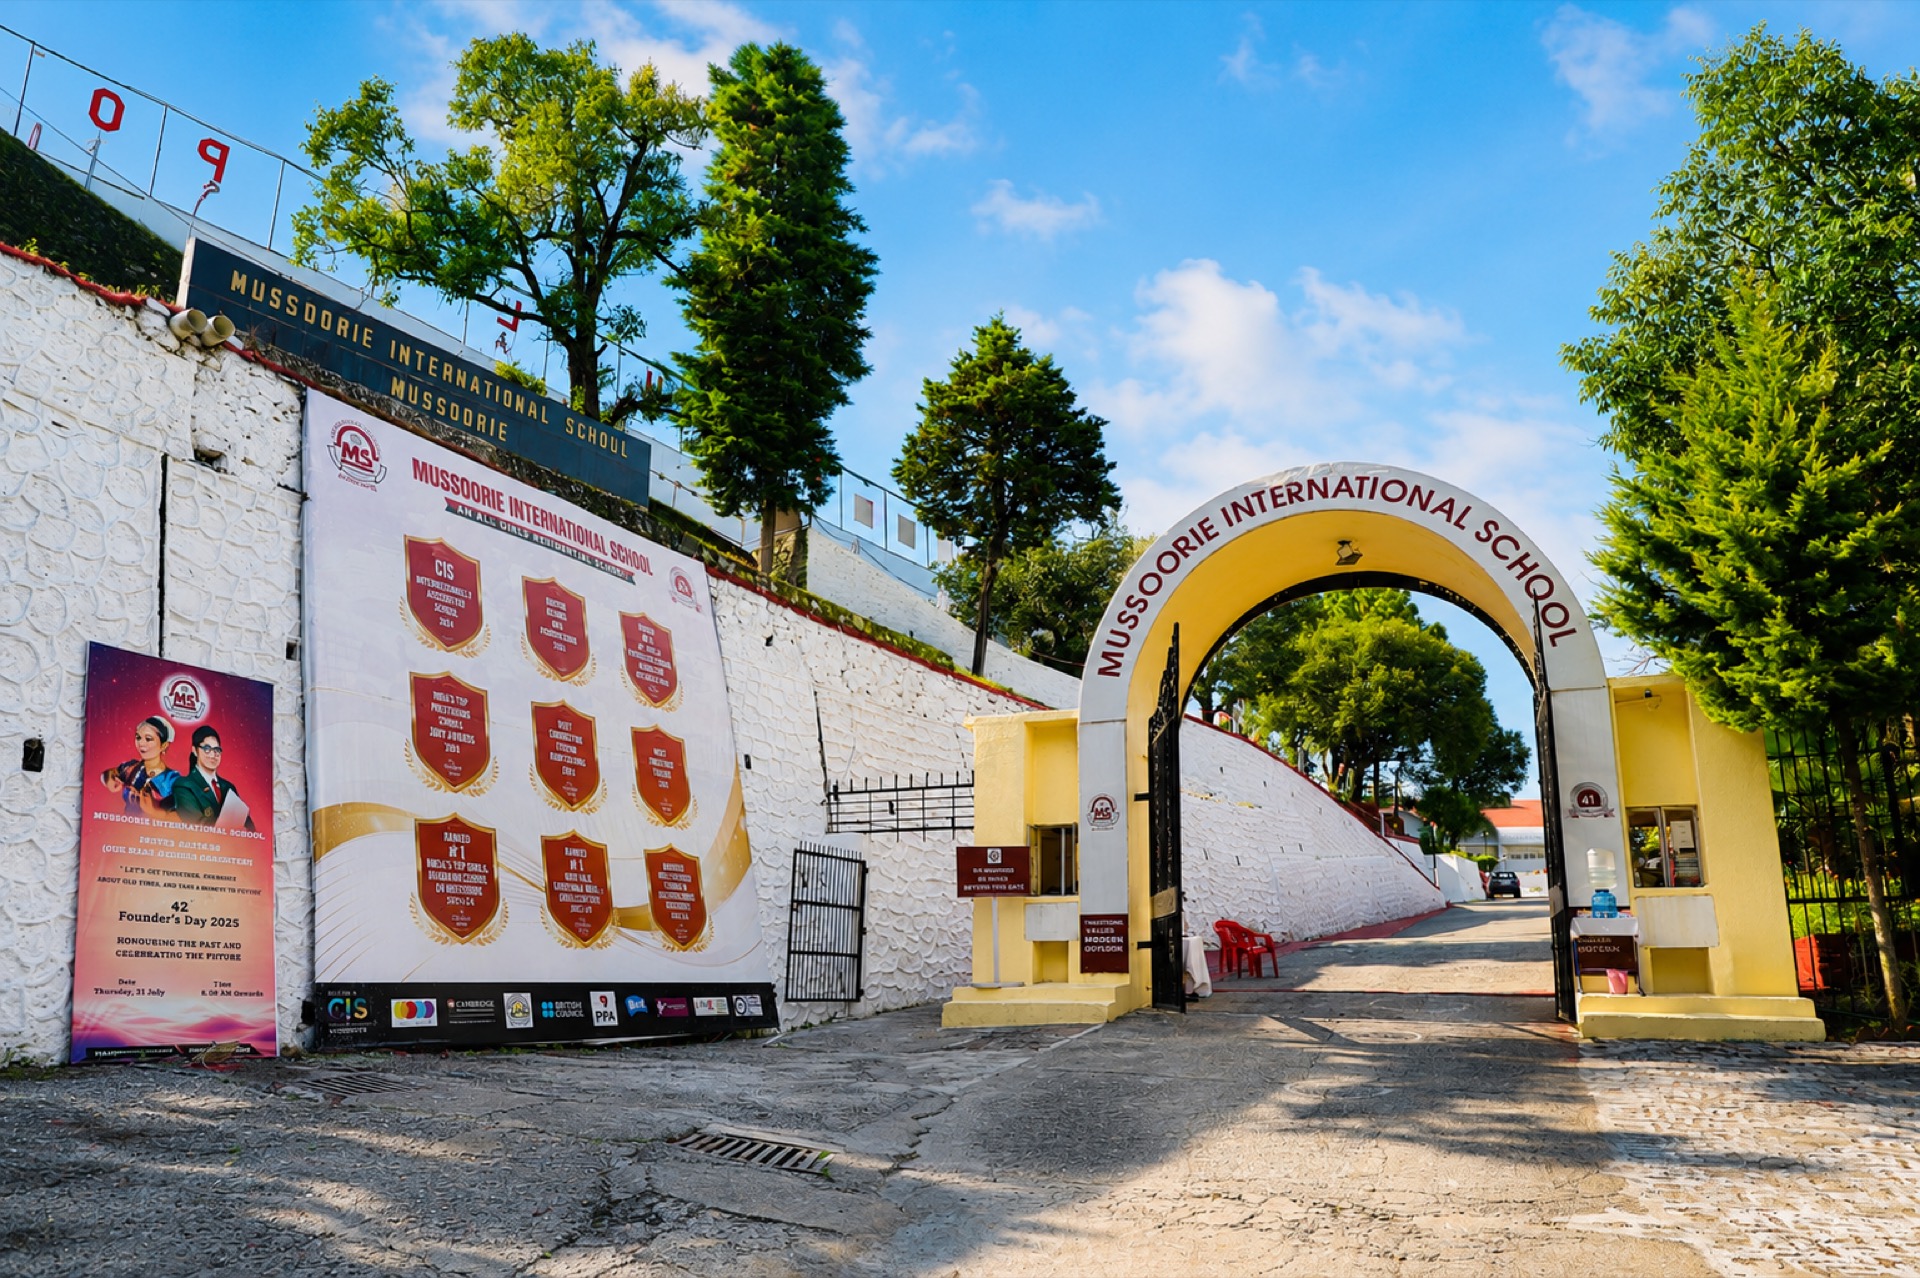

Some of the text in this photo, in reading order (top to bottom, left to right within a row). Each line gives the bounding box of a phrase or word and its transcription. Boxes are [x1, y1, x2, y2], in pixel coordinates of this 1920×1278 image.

[390, 339, 549, 425] INTERNATIONAL
[412, 457, 653, 576] MUSSOORIE INTERNATIONAL SCHOOL
[435, 559, 455, 581] CIS
[1098, 475, 1578, 679] MUSSOORIE INTERNATIONAL SCHOOL
[171, 901, 189, 913] 42
[119, 911, 240, 928] Founder's Day 2025
[199, 940, 221, 949] PAST
[595, 1011, 616, 1023] PPA
